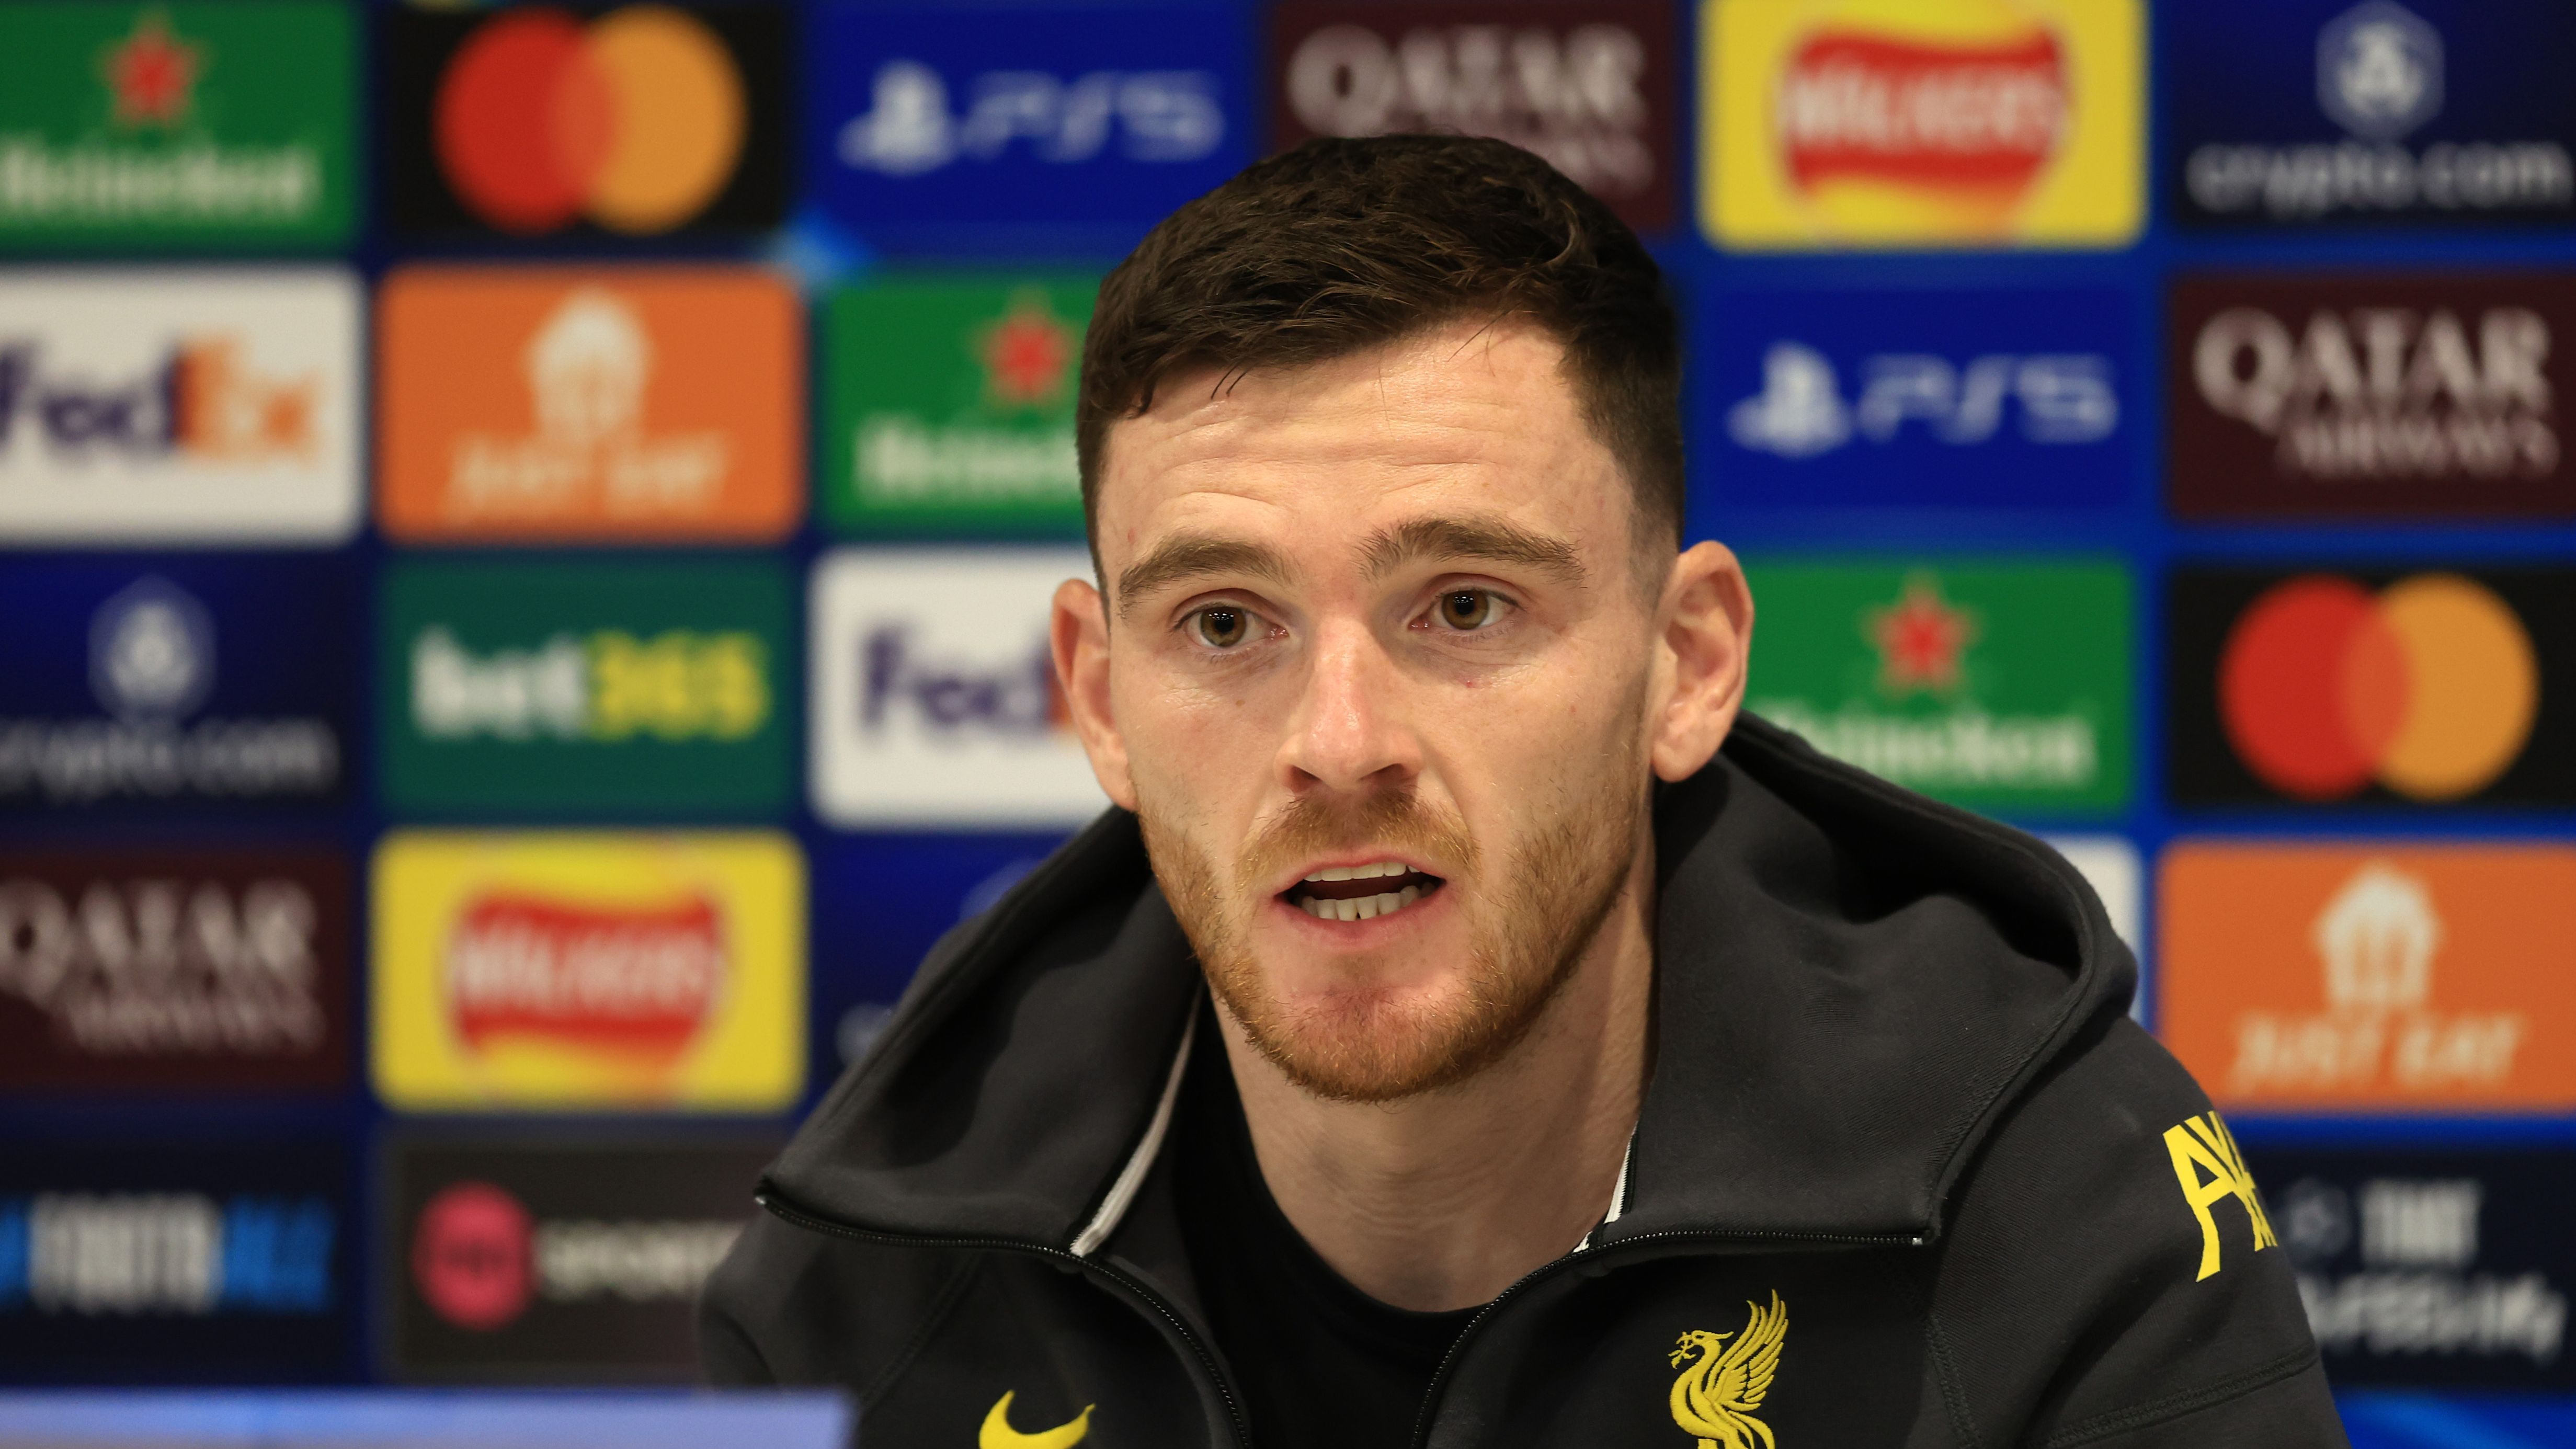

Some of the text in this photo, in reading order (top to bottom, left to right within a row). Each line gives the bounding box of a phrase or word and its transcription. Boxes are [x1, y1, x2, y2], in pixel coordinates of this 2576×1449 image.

[970, 72, 1223, 158] PS5
[1294, 27, 1645, 133] QATAR
[2191, 145, 2570, 213] crypto.com
[1866, 358, 2115, 440] PS5
[2199, 313, 2555, 430] QATAR
[2283, 410, 2557, 476] AIRWAYS
[417, 627, 763, 735] bet365
[853, 620, 1082, 740] Fed
[2234, 1016, 2525, 1090] JUST EAT
